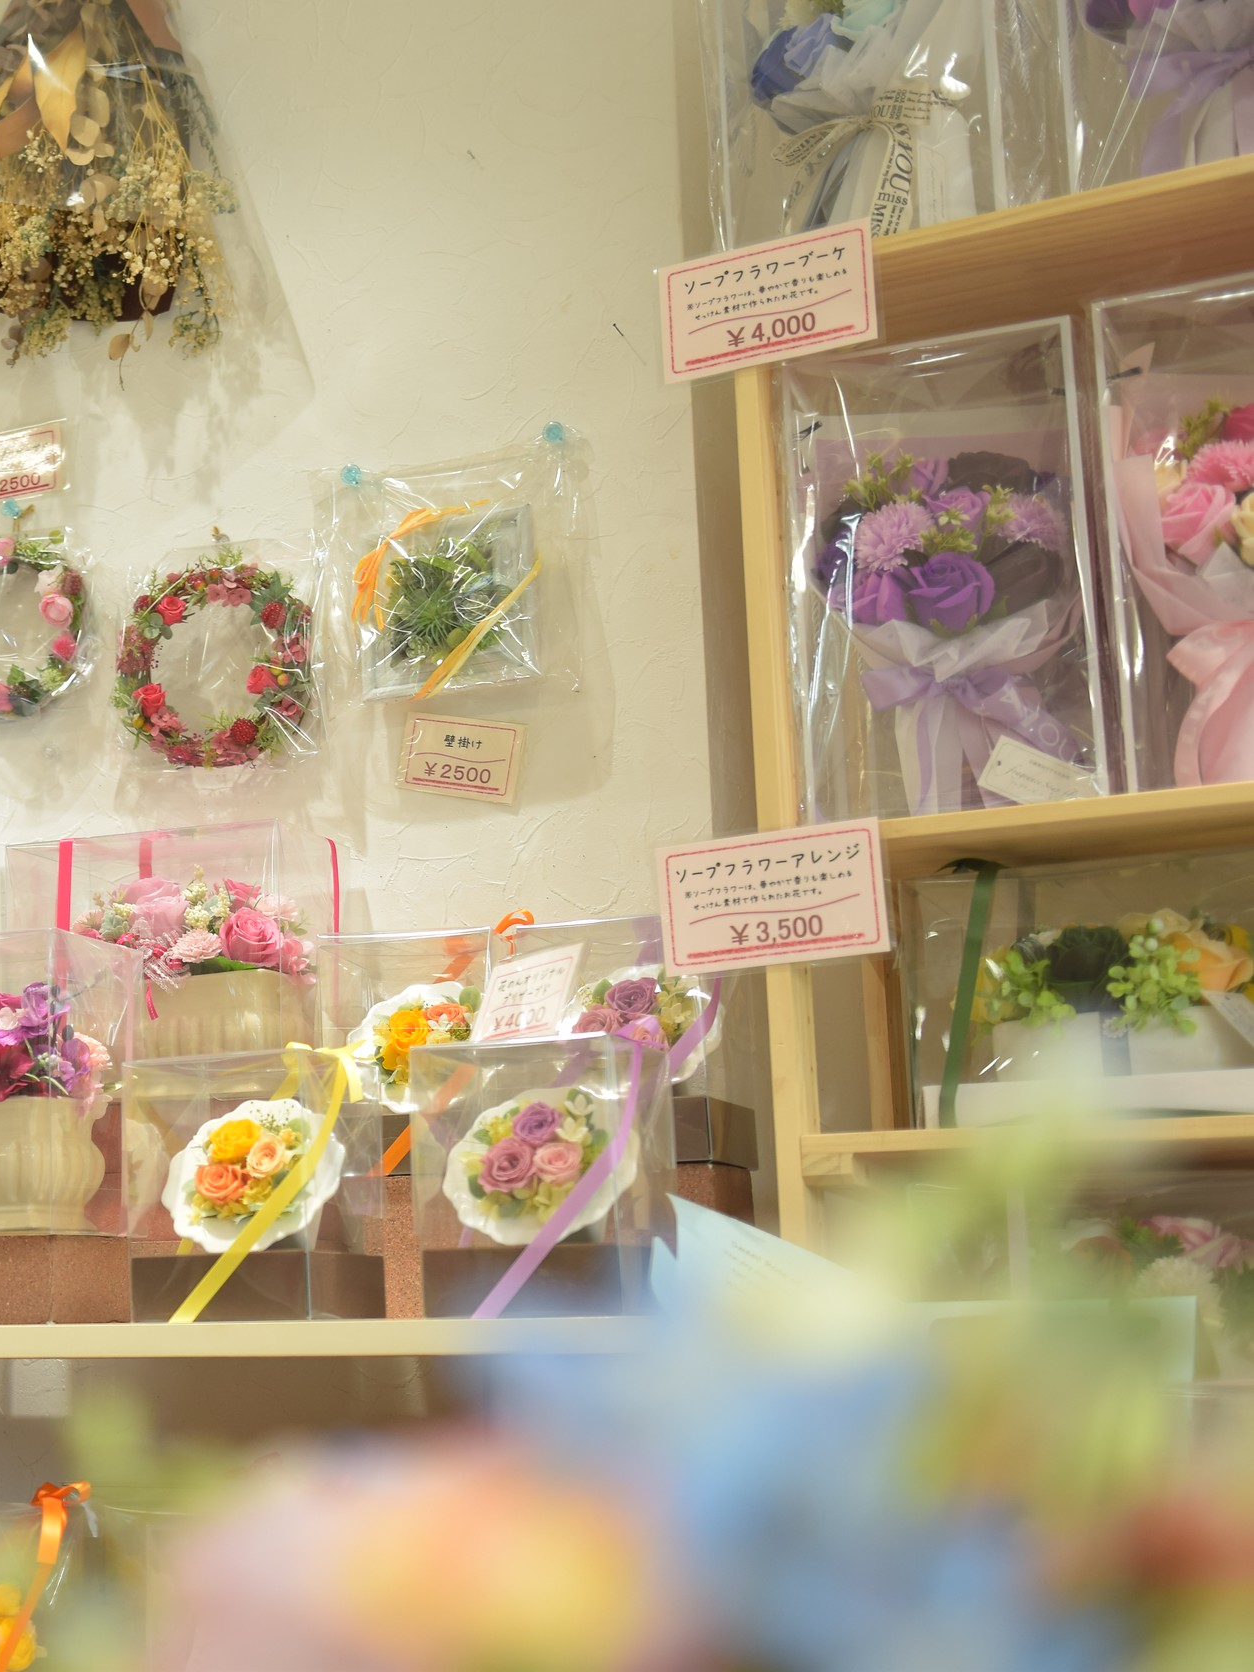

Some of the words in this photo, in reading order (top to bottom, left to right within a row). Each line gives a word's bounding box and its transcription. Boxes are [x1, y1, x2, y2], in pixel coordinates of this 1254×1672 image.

[877, 192, 908, 206] miss
[684, 246, 846, 295] ソープフラワーブーケ
[726, 312, 816, 347] ¥4,000
[444, 734, 483, 749] 壁掛け
[424, 761, 491, 784] ¥2500
[676, 844, 861, 883] ソープフラワーアレンジ
[730, 915, 823, 945] ¥3,500
